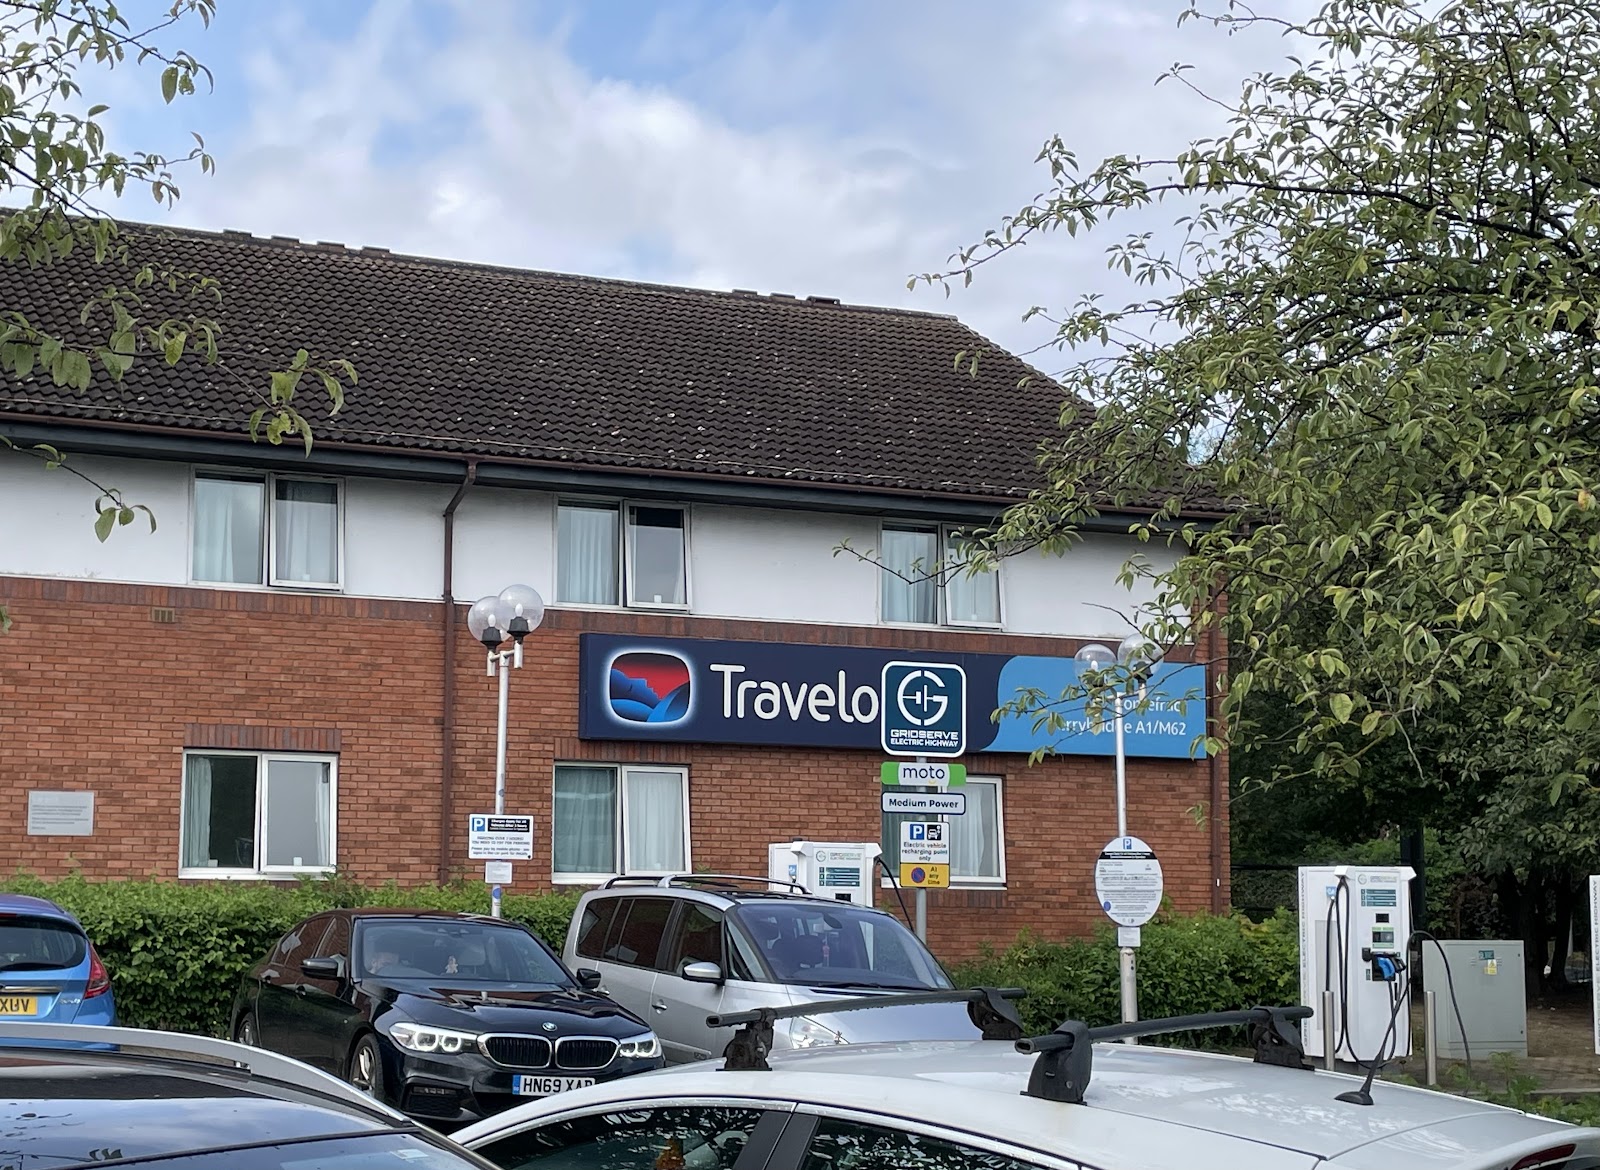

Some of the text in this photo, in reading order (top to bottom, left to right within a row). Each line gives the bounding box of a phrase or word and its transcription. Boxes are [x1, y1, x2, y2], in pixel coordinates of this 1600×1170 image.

[890, 729, 959, 740] GRIDSERVE
[1135, 720, 1187, 736] A1/M62
[890, 738, 959, 748] ELECTRIC HIGHWAY
[903, 766, 945, 780] moto
[889, 798, 959, 809] Medium Power
[912, 825, 923, 839] P
[0, 998, 30, 1012] XUV
[523, 1077, 562, 1093] HN69
